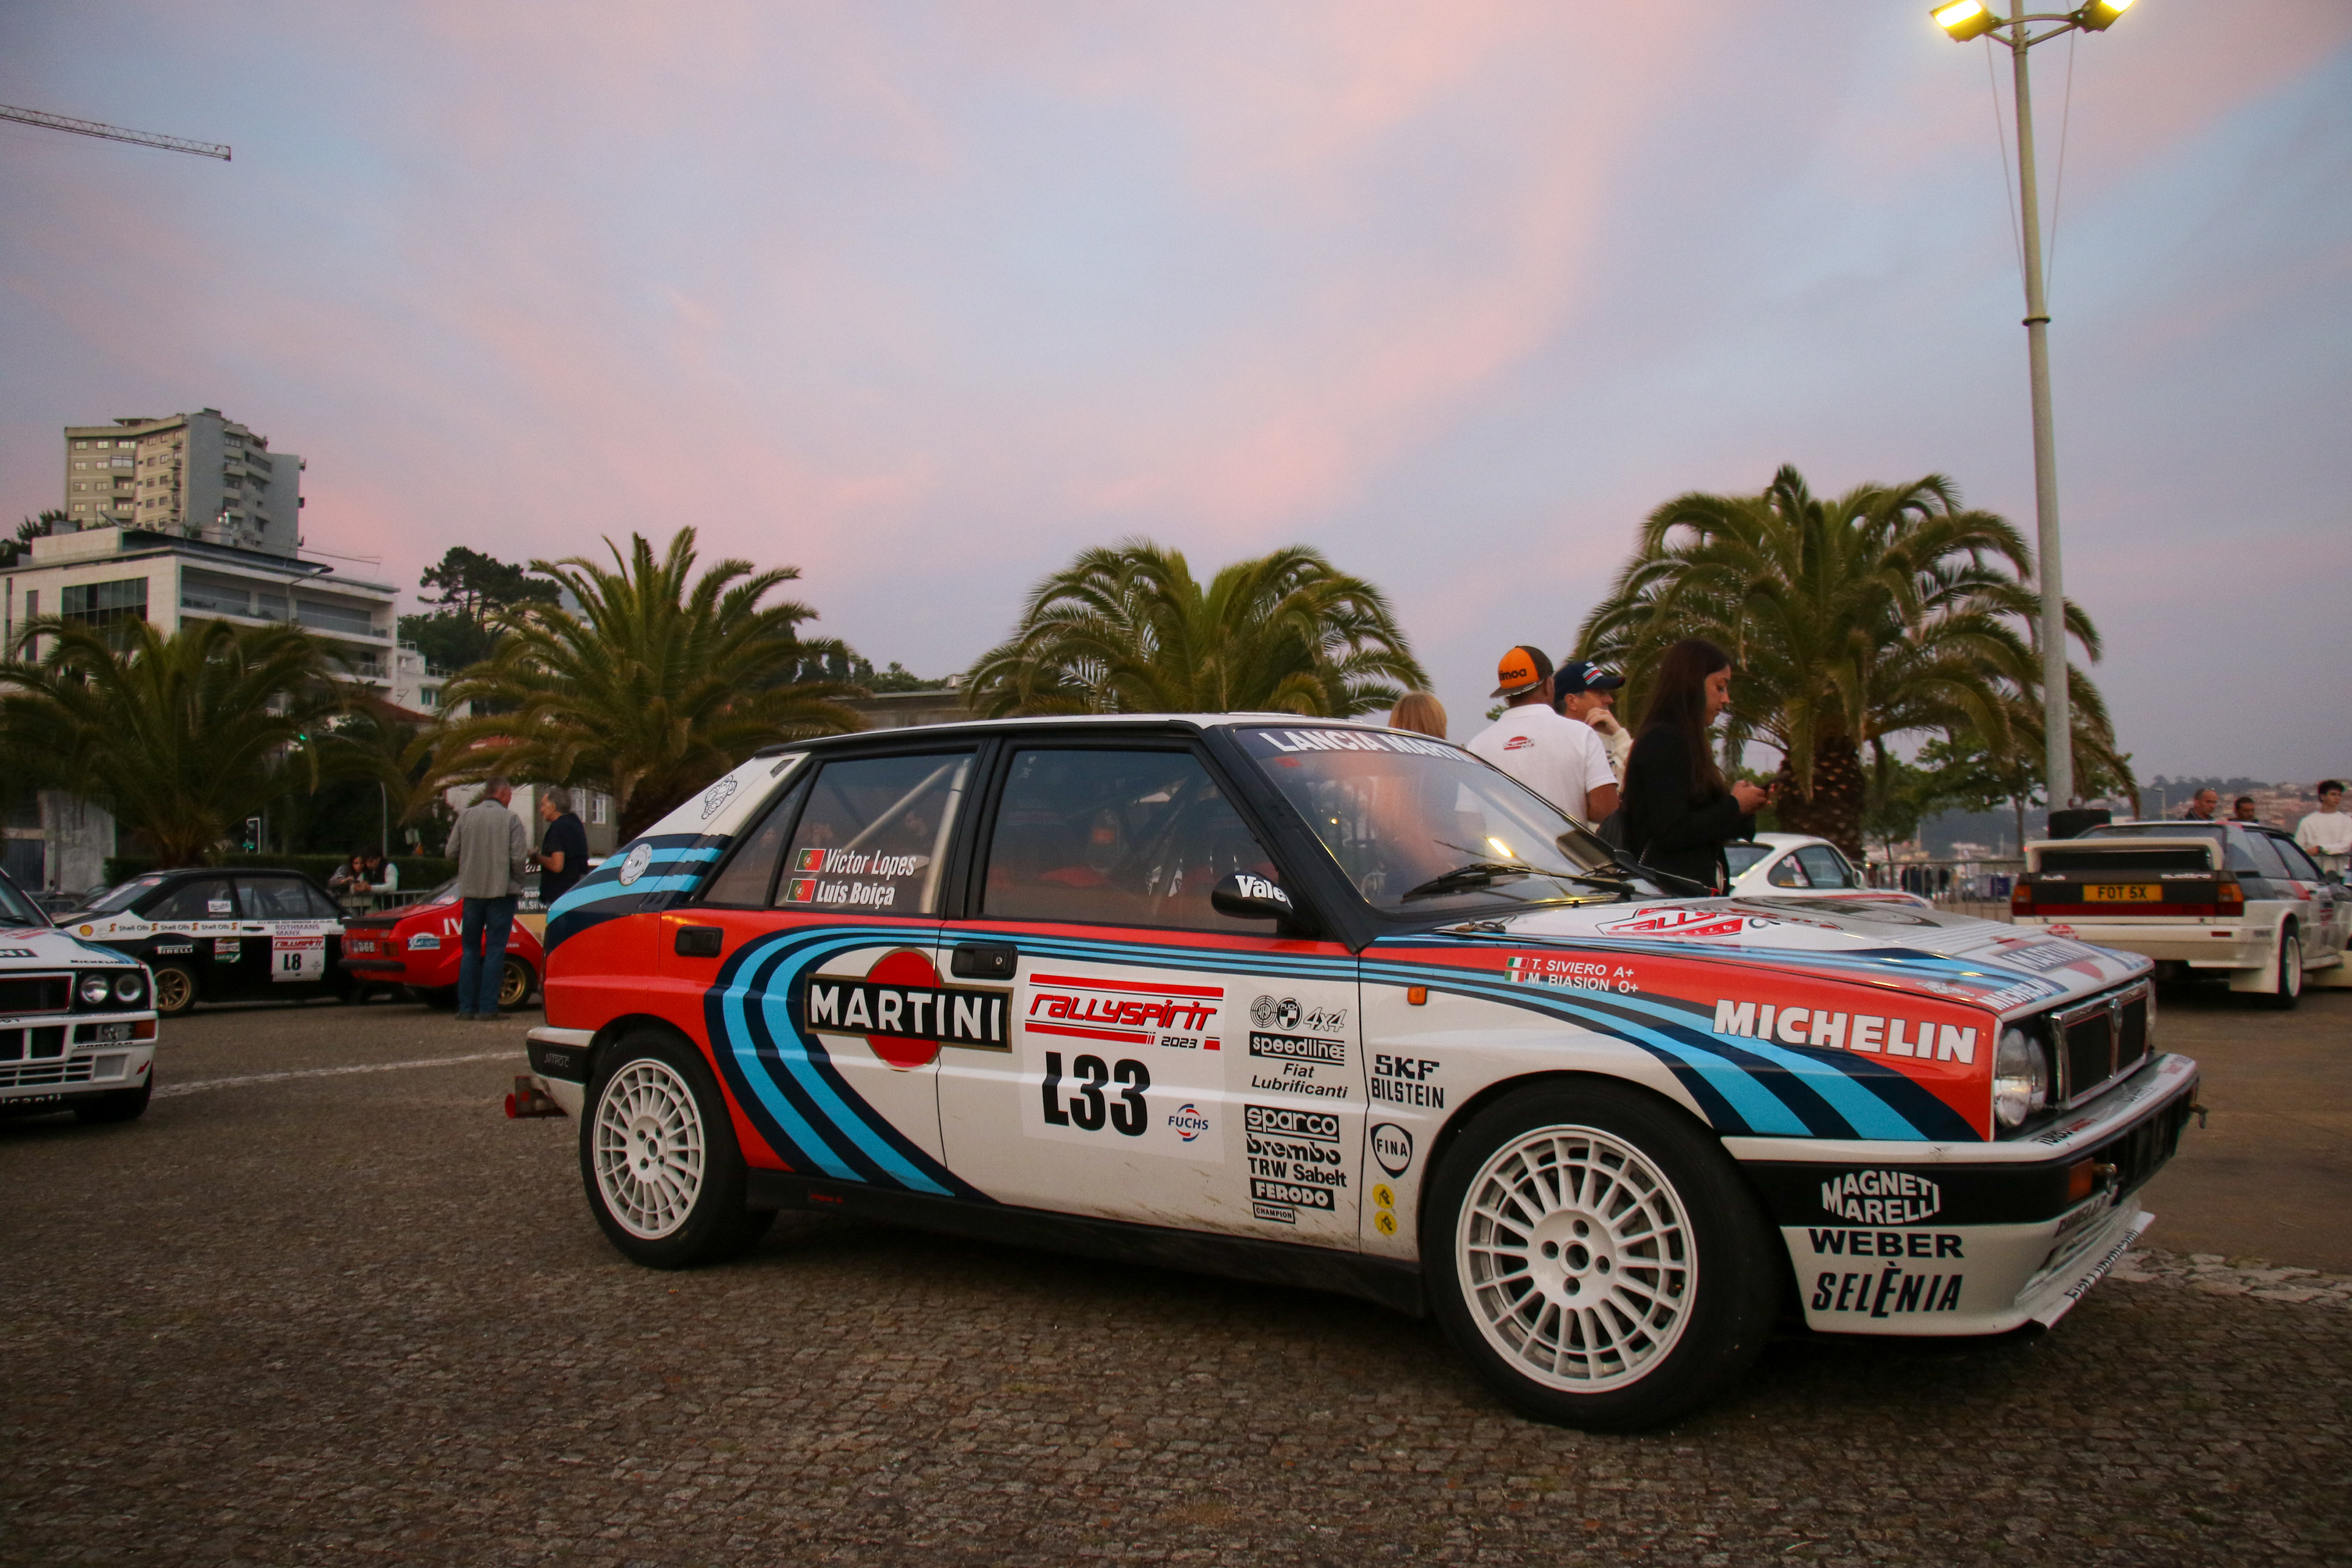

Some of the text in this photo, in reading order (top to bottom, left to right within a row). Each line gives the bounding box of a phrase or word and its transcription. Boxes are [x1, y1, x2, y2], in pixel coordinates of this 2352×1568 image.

[1259, 731, 1391, 752] LANCIA
[825, 849, 917, 880] Victor Lopes
[517, 901, 547, 910] M.Silv
[816, 880, 895, 910] Luís Boiça
[2098, 887, 2147, 899] FOT 5X
[157, 945, 193, 954] PIRELLI
[284, 954, 301, 971] L8
[2000, 941, 2093, 971] MARTINI
[1532, 958, 1634, 978] T. SIVIERO A+
[1528, 972, 1543, 986] M.
[1548, 974, 1610, 992] BIASION
[1975, 978, 2056, 1011] MICHELIN
[811, 984, 1001, 1041] MARTINI
[1303, 1006, 1348, 1033] 4x4
[1161, 1036, 1198, 1049] 2023
[1713, 998, 1978, 1065] MICHELIN
[1253, 1036, 1344, 1060] speedline
[1283, 1063, 1314, 1078] Fiat
[1374, 1054, 1440, 1080] SKF
[1042, 1051, 1151, 1137] L33
[1251, 1074, 1348, 1099] Lubrificanti
[1371, 1077, 1444, 1109] BILSTEIN
[1168, 1115, 1208, 1131] FUCHS
[1246, 1106, 1338, 1136] sparco
[1246, 1134, 1341, 1165] brembo
[1376, 1138, 1408, 1157] FINA
[1248, 1157, 1348, 1187] TRW Sabelt
[1256, 1182, 1330, 1207] FERODO
[1822, 1170, 1940, 1202] MAGNETI
[1256, 1207, 1292, 1219] CHAMPION
[1822, 1197, 1940, 1224] MARELLI
[1807, 1228, 1965, 1258] WEBER
[1811, 1261, 1963, 1318] SELÈNIA
